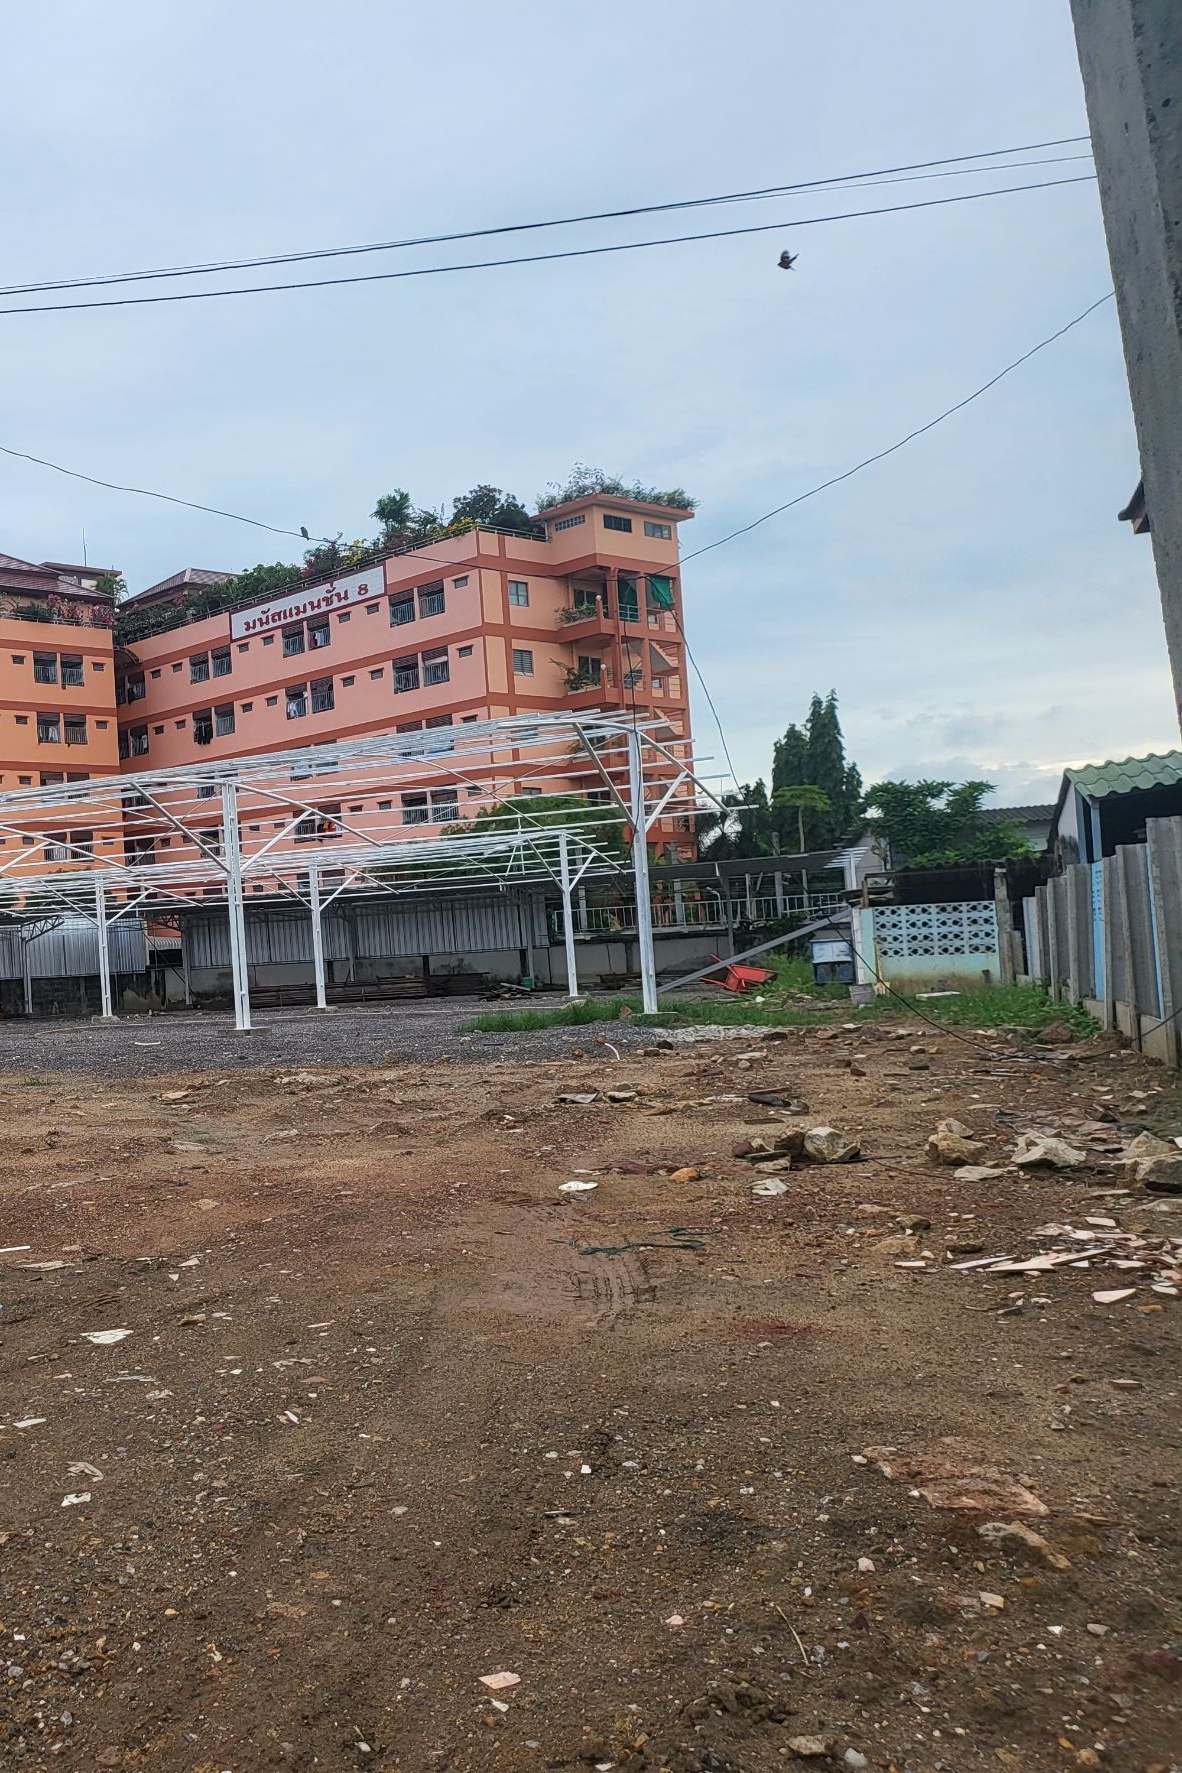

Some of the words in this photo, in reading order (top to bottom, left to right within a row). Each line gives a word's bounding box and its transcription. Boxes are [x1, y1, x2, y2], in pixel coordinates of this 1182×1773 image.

[244, 582, 349, 632] มนัสแมนชั่น
[357, 583, 369, 596] 8
